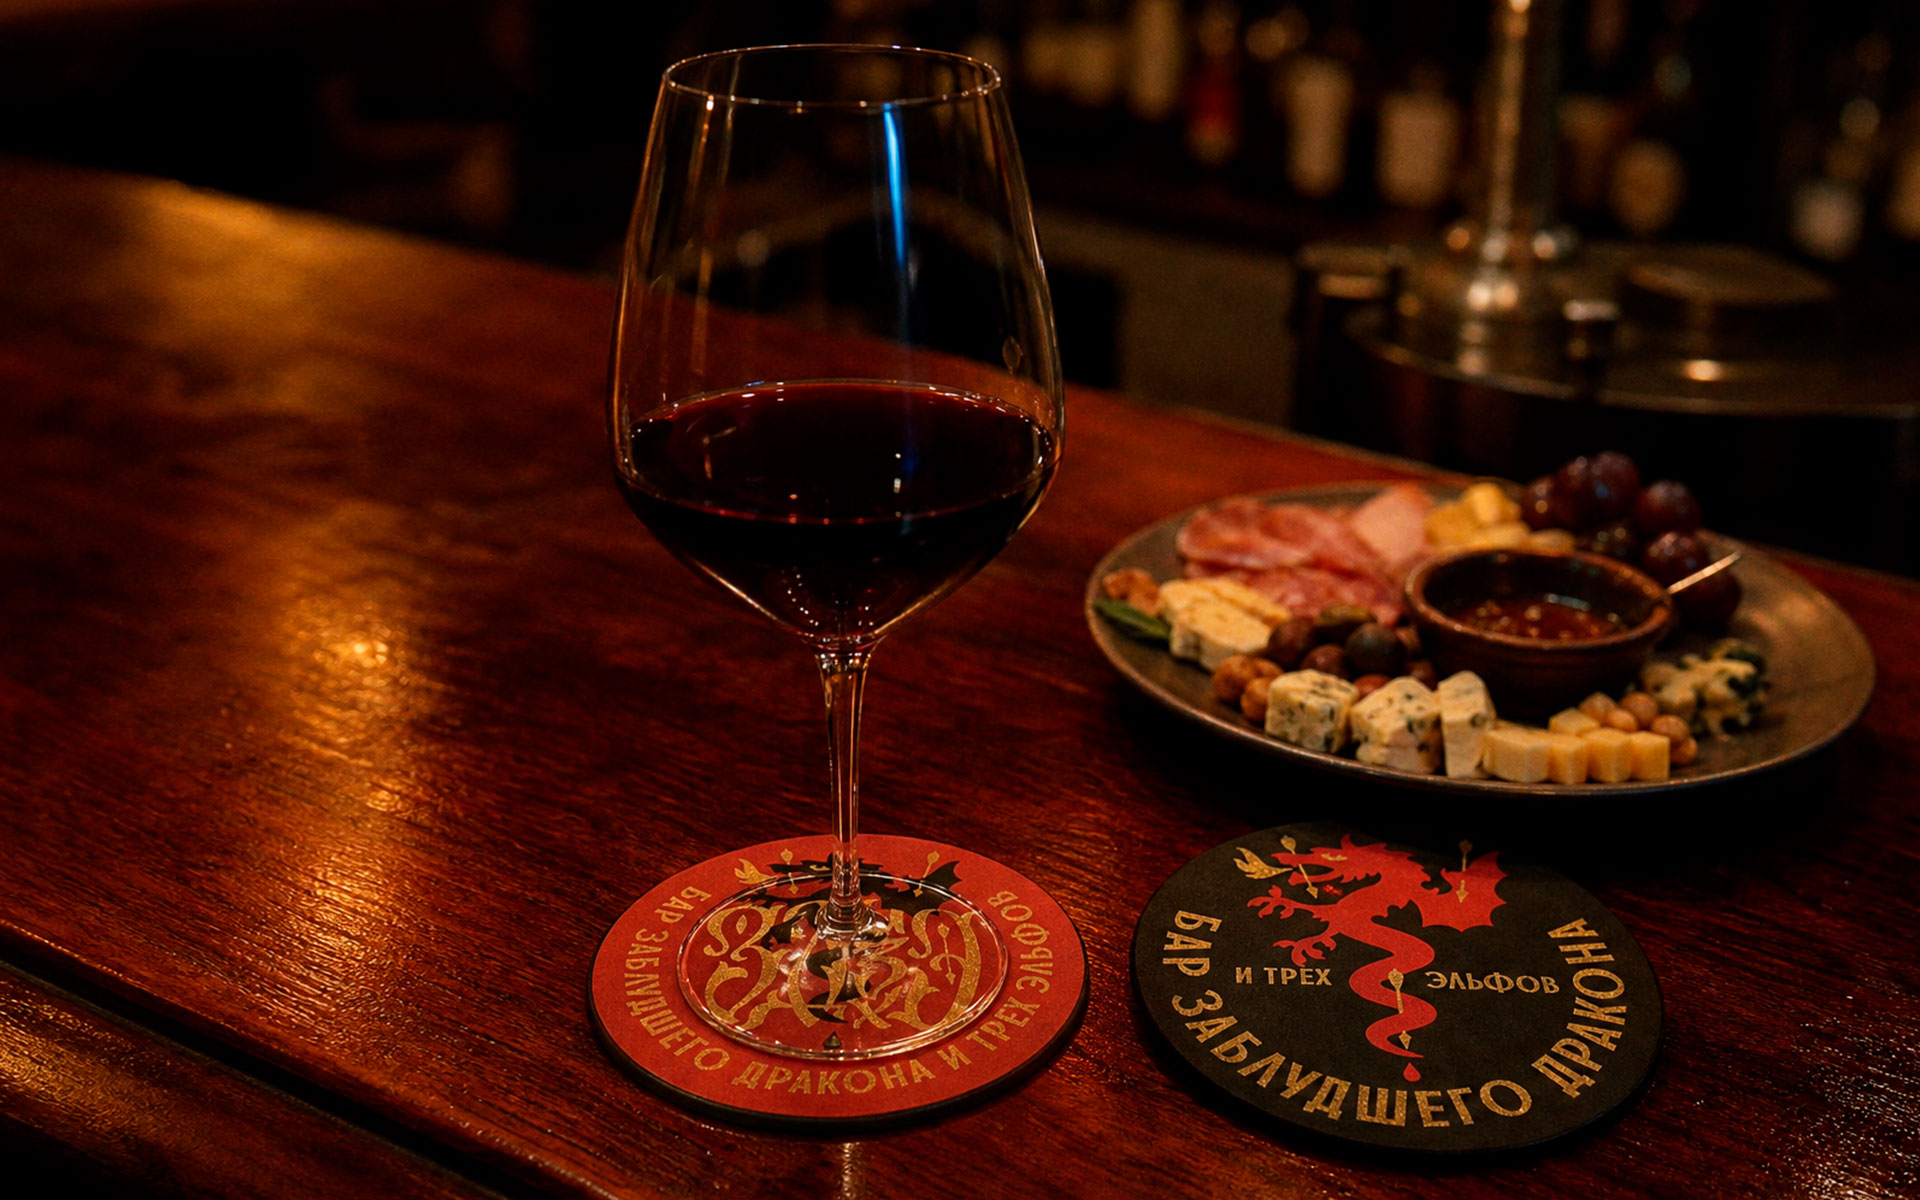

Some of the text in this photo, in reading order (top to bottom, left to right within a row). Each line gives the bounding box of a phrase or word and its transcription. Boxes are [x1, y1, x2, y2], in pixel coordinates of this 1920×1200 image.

[624, 886, 1053, 1095] БАР ЗАБЛУДШЕГО ДРАКОНА И ТРЕХ ЭЛЬФОВ
[1163, 910, 1627, 1128] БАР ЗАБЛУДШЕГО ДРАКОНА
[1235, 967, 1560, 994] И ТРЕХ ЭЛЬФОВ
